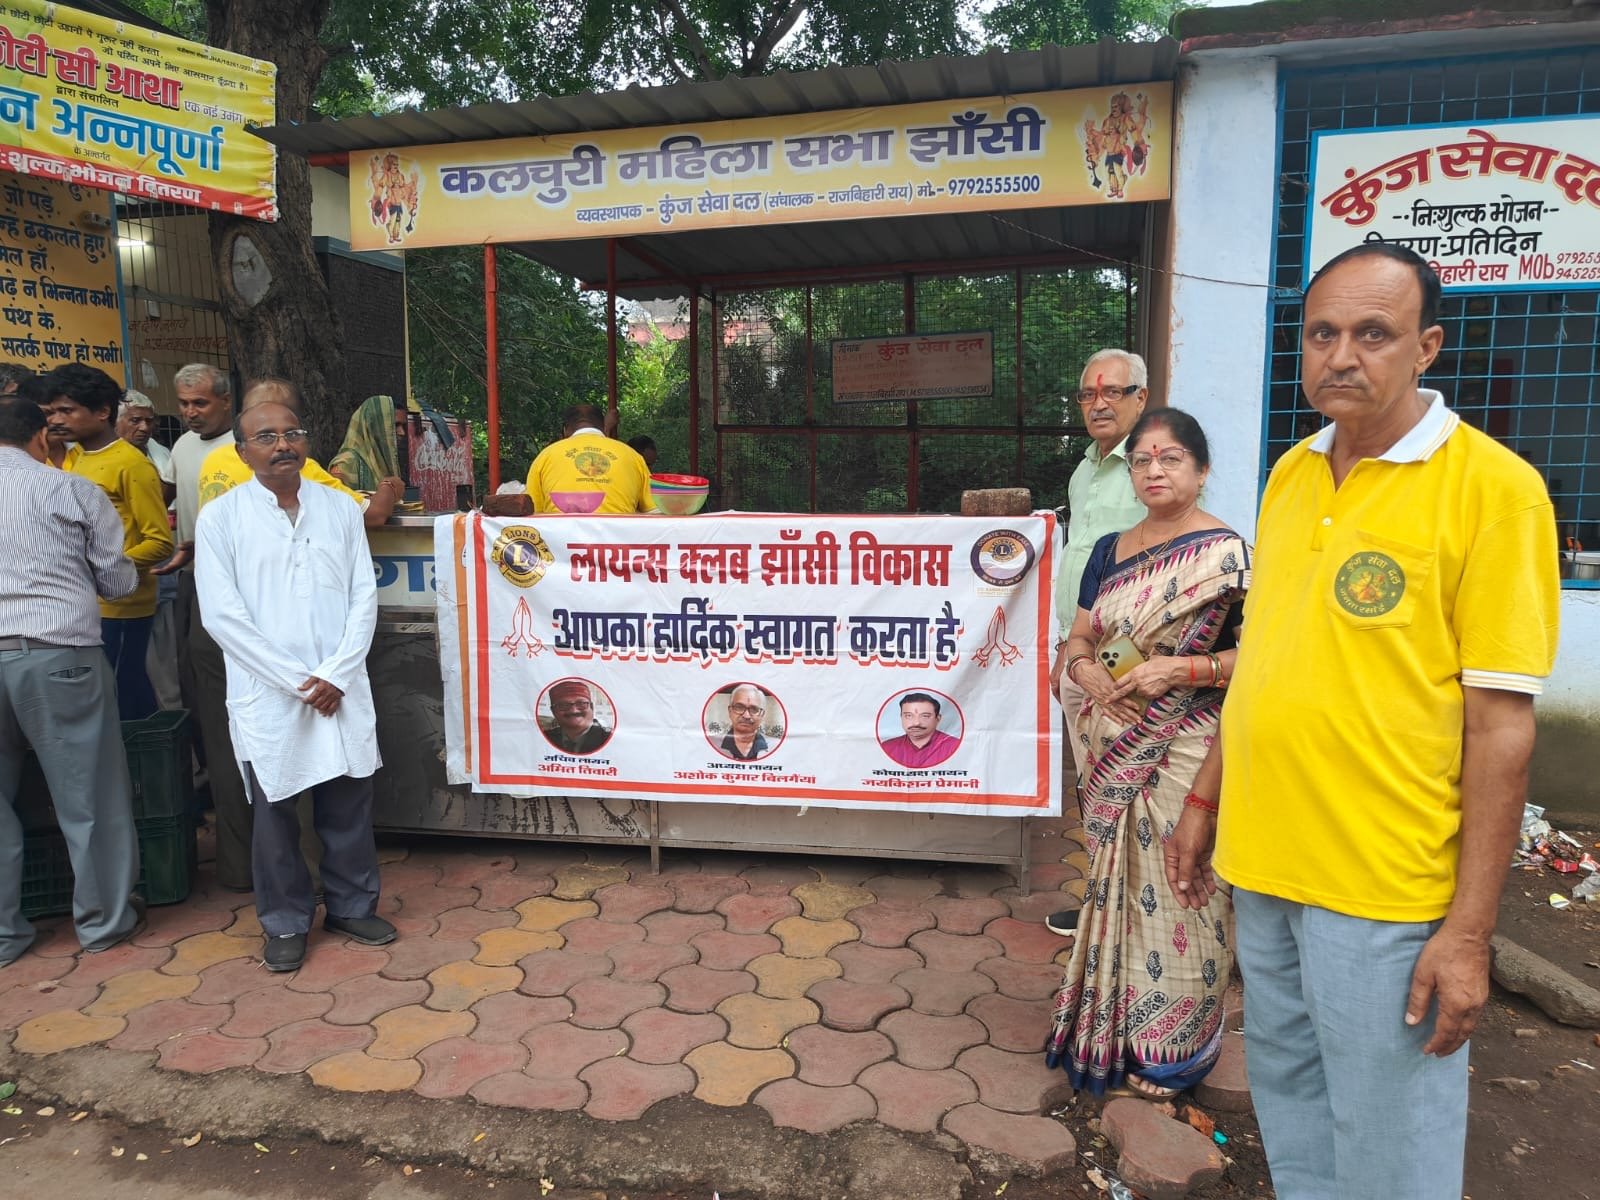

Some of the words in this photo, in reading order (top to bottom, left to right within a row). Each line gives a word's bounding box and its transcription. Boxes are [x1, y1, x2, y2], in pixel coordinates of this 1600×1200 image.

[54, 48, 99, 90] सी
[106, 63, 182, 110] आशा
[184, 100, 200, 113] एक
[204, 104, 218, 118] नई
[56, 85, 76, 100] द्वारा
[80, 88, 120, 109] संचालित
[0, 86, 40, 131] न
[52, 98, 224, 175] अन्नपूर्णा
[440, 144, 607, 204] कलचुरी
[617, 135, 774, 181] महिला
[784, 128, 894, 168] सभा
[906, 106, 1046, 164] झाँसी
[70, 162, 132, 190] भोजन
[138, 175, 202, 204] वितरण
[1321, 148, 1434, 226] कुंज
[1436, 128, 1560, 182] सेवा
[576, 204, 643, 222] व्यवस्थापक
[658, 194, 694, 223] कुंज
[698, 190, 731, 213] सेवा
[732, 191, 762, 211] दल
[948, 174, 1040, 196] 9792555500
[1478, 264, 1509, 282] राय
[22, 280, 38, 299] न
[40, 275, 88, 305] भिन्नता
[2, 304, 33, 328] पंथ
[1, 333, 40, 358] सतर्क
[877, 340, 912, 362] कुंज
[916, 338, 951, 355] सेवा
[505, 530, 537, 540] LIONS
[512, 544, 530, 567] L
[567, 544, 671, 584] लायन्स
[678, 544, 752, 585] क्लब
[759, 530, 842, 587] झाँसी
[850, 531, 953, 587] विकास
[1368, 554, 1388, 569] सेवा
[552, 608, 648, 656] आपका
[652, 597, 738, 664] हार्दिक
[744, 615, 838, 660] स्वागत
[849, 616, 930, 663] करता
[935, 600, 961, 665] है
[538, 762, 576, 774] अमित
[578, 765, 618, 776] तिवारी
[674, 770, 718, 780] अशोक
[721, 772, 760, 784] कुमार
[862, 778, 932, 788] जयकिशन
